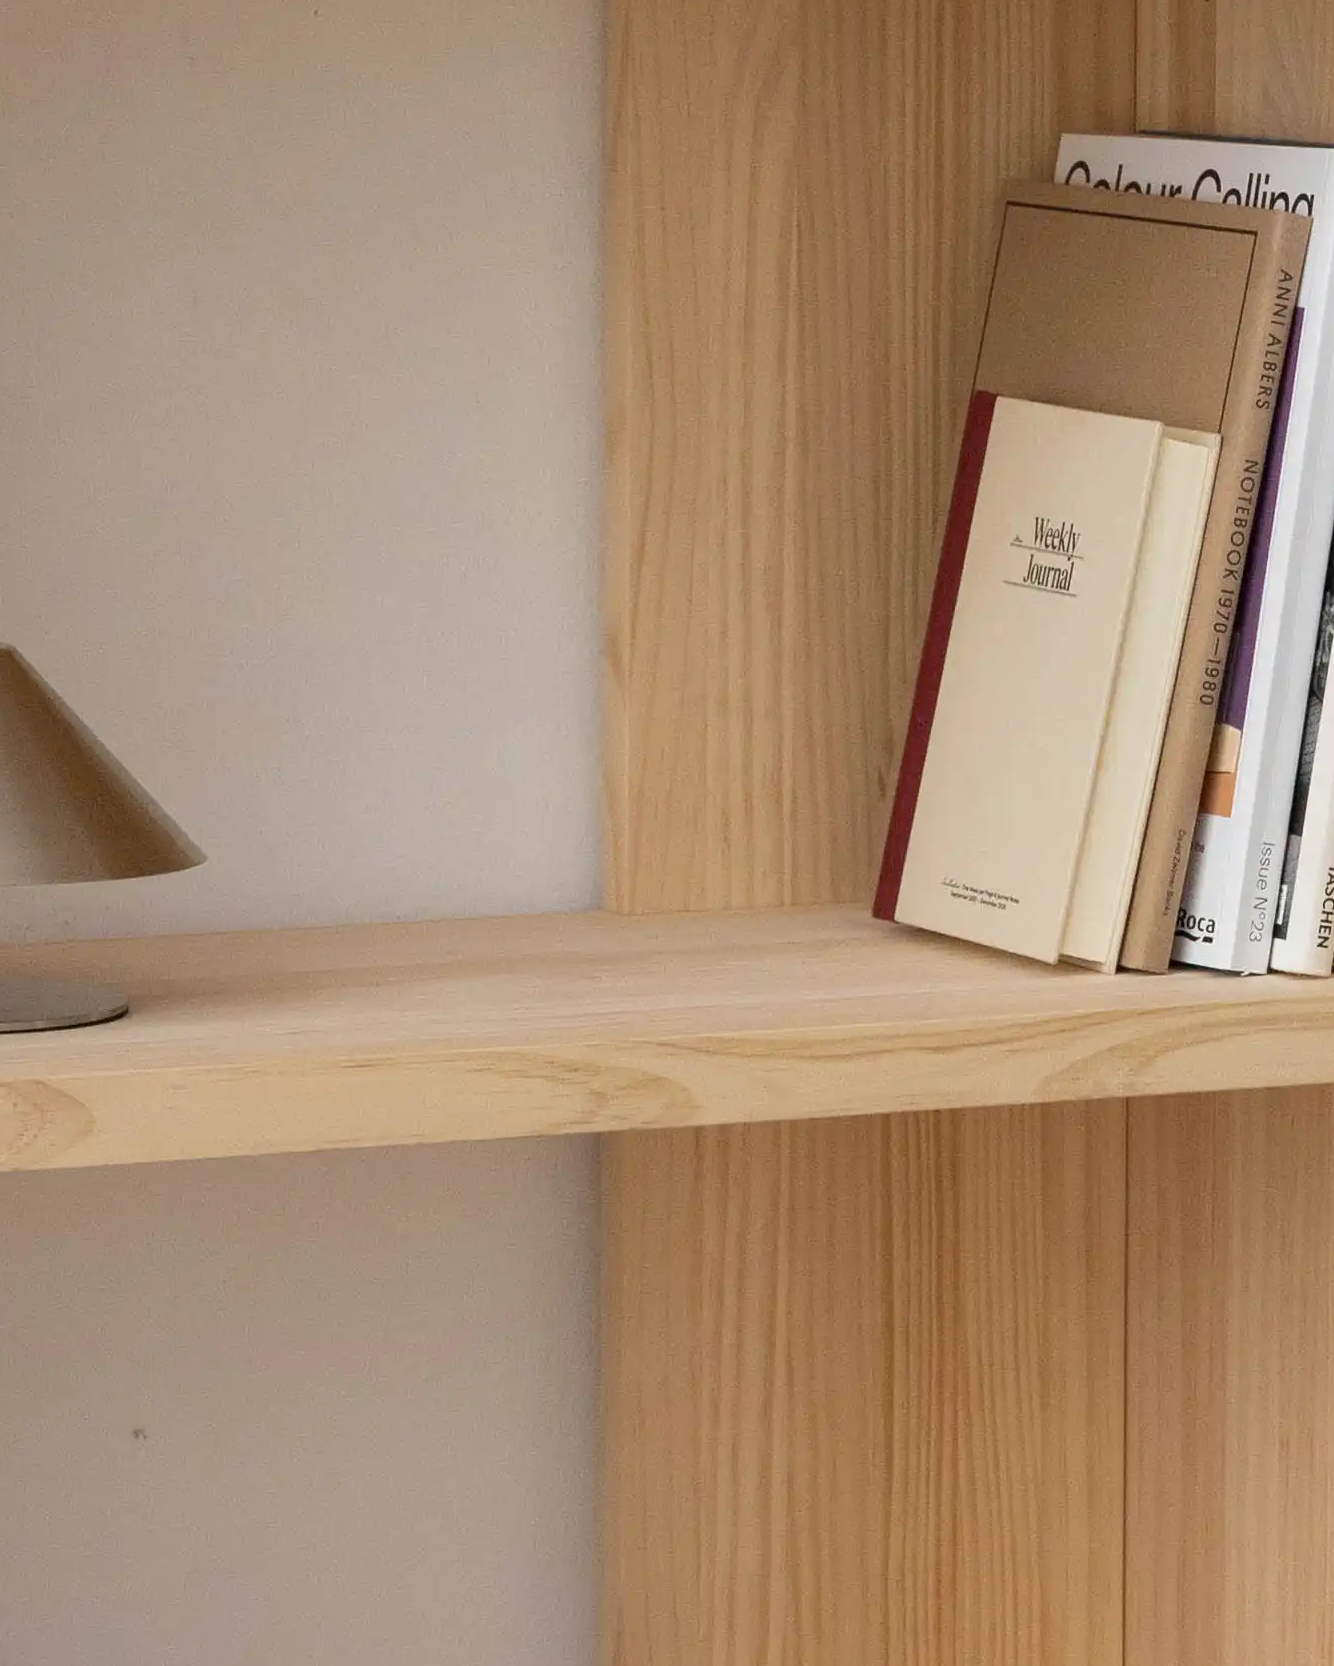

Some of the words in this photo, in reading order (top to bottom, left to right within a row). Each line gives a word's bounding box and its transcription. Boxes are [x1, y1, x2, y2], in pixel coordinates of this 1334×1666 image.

[1271, 269, 1294, 326] ANNI
[1255, 333, 1282, 410] ALBERS
[1033, 516, 1081, 561] Weekly
[1222, 459, 1260, 581] NOTEBOOK
[1023, 553, 1075, 592] Journal
[1256, 841, 1276, 891] Issue
[1176, 908, 1216, 934] Roca
